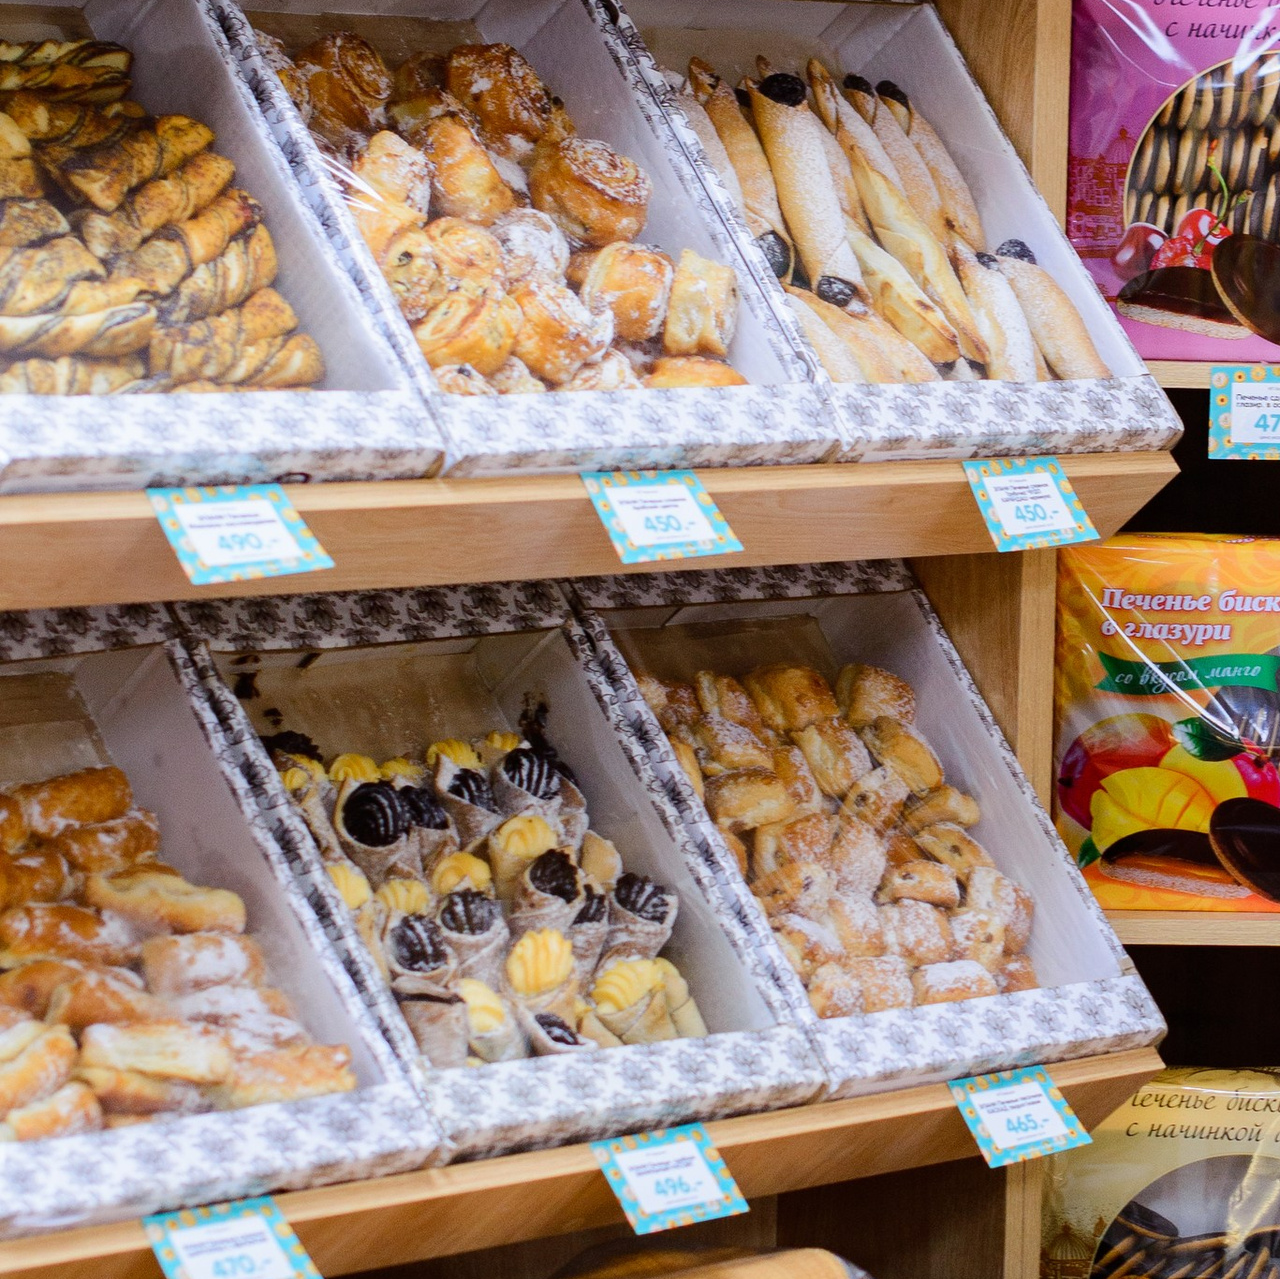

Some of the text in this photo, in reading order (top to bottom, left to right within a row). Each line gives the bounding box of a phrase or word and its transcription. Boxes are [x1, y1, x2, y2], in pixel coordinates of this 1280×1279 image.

[1165, 22, 1179, 37] с
[1236, 394, 1268, 402] Печенье
[1015, 503, 1059, 521] 450.-
[1102, 588, 1211, 611] Печенье
[1125, 621, 1231, 644] глазури
[1115, 663, 1262, 693] со вкусом манго
[1126, 1122, 1139, 1137] с
[1148, 1122, 1262, 1142] начинкой
